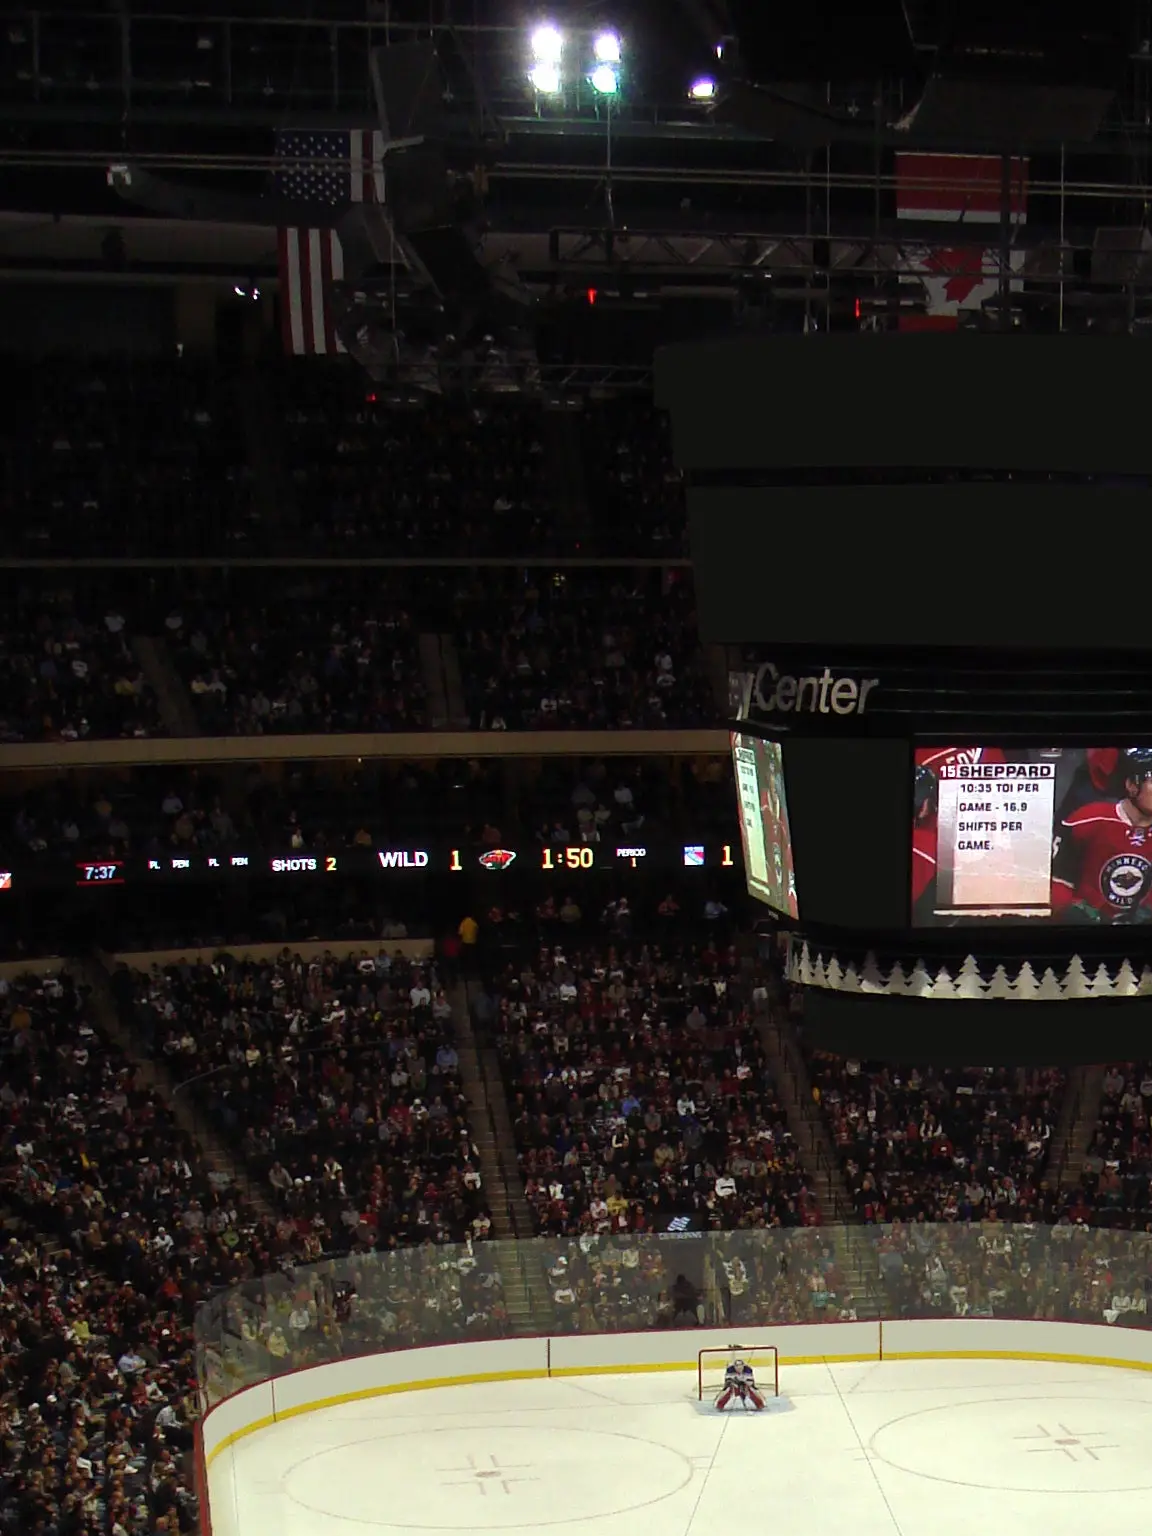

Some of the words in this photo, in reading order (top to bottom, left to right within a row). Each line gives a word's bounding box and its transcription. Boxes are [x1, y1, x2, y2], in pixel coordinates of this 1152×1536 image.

[754, 663, 879, 715] Center
[940, 764, 956, 777] 15
[959, 765, 1051, 777] SHEPPARD
[961, 783, 992, 793] 10:35
[995, 783, 1014, 793] TOI
[1016, 783, 1039, 793] PER
[959, 802, 992, 812] GAME
[1003, 802, 1027, 812] 16.9
[958, 821, 997, 832] SHIFTS
[1001, 821, 1022, 832] PER
[958, 839, 994, 851] GAME.
[379, 851, 428, 868] WILD
[450, 850, 462, 870] 1
[542, 848, 593, 869] 1:50
[721, 845, 733, 866] 1
[272, 858, 317, 871] SHOTS
[326, 857, 337, 871] 2
[85, 865, 116, 880] 7:37
